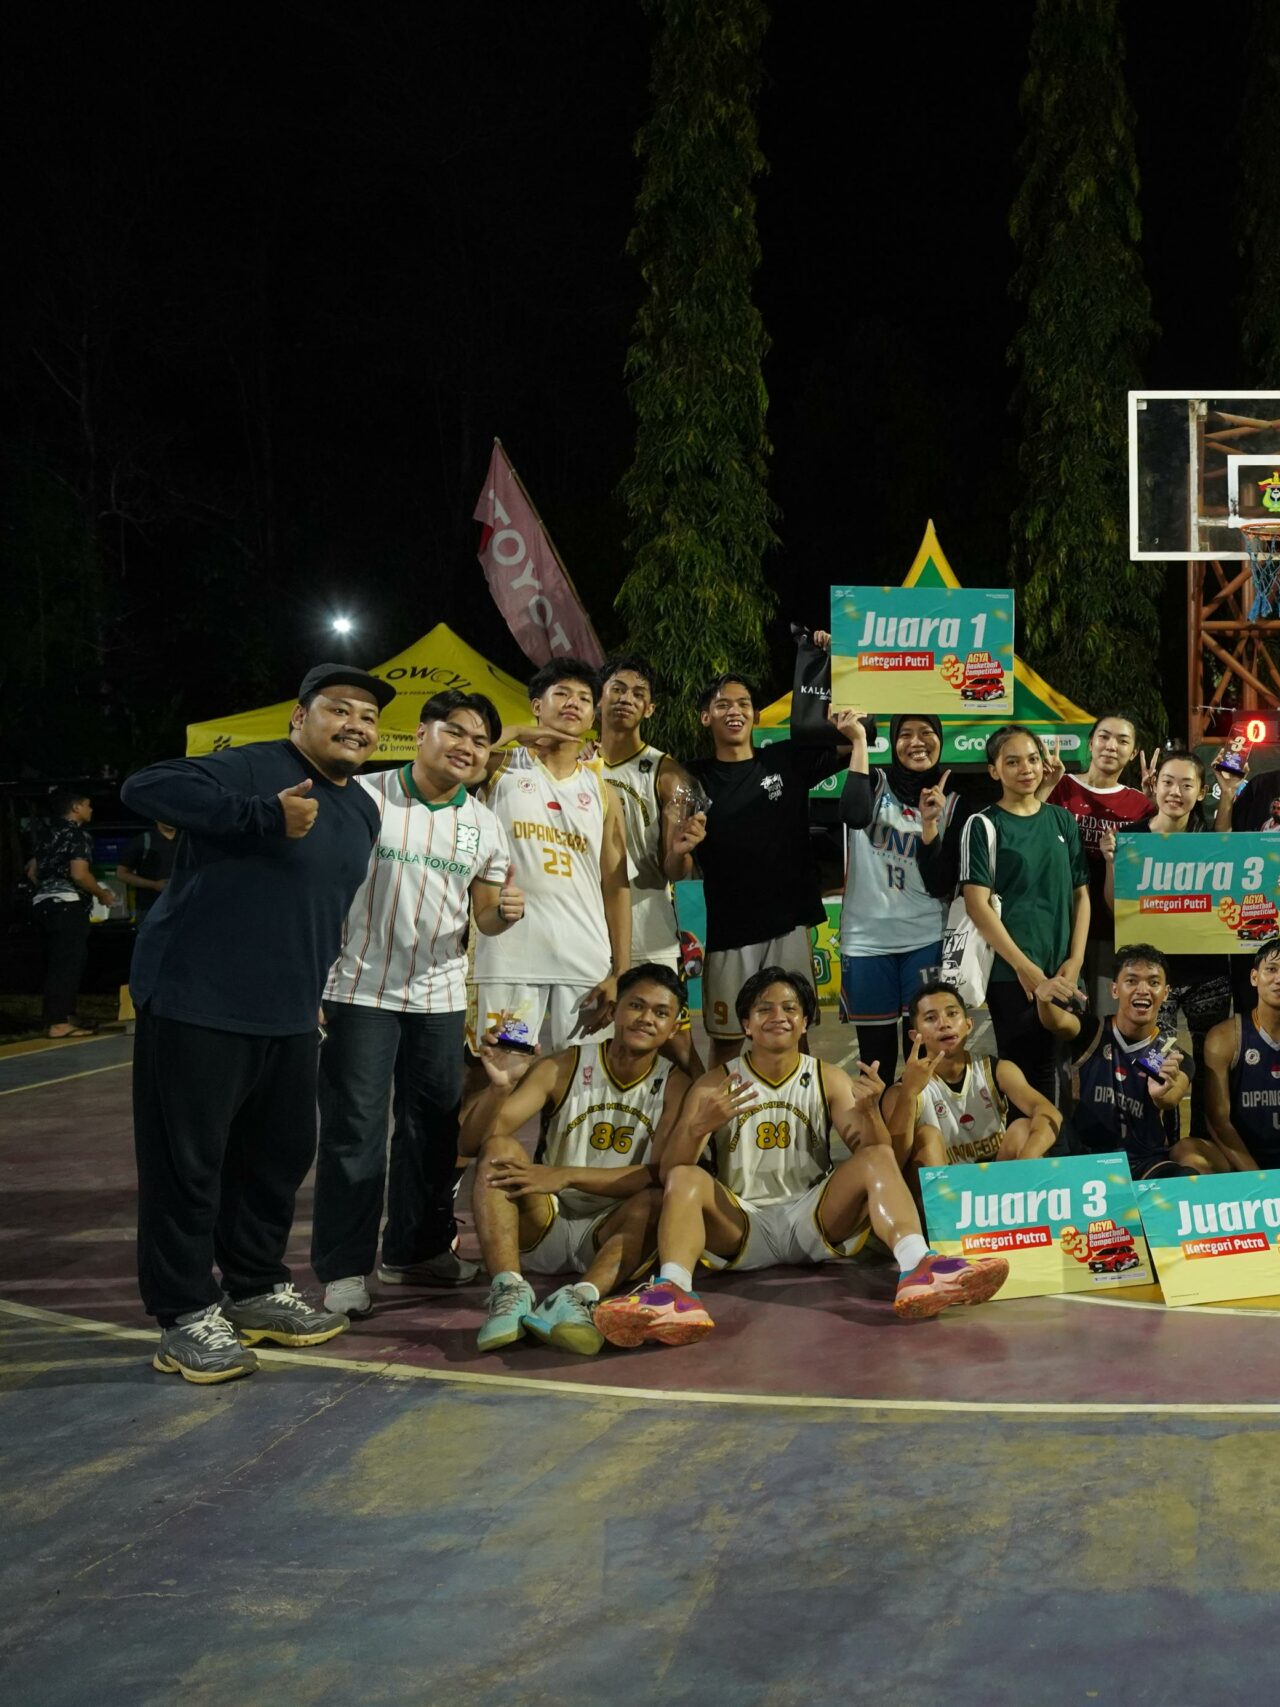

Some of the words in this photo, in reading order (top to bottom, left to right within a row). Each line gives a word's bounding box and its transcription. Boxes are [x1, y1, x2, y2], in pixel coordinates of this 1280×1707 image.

[488, 489, 572, 651] TOYOT
[858, 611, 961, 648] Juara
[971, 613, 987, 648] 1
[905, 655, 930, 667] Putri
[385, 664, 473, 690] OWCYL
[800, 685, 832, 695] KALLA
[954, 734, 990, 751] Gra
[1246, 720, 1266, 742] 0
[872, 828, 919, 858] UN
[376, 847, 420, 863] KALLA
[423, 856, 472, 876] TOYOTA
[542, 847, 573, 878] 23
[1136, 857, 1234, 891] Juara
[1241, 856, 1265, 891] 3
[886, 864, 906, 890] 13
[1184, 897, 1207, 909] Putri
[713, 1001, 728, 1025] 9
[590, 1122, 634, 1154] 86
[756, 1120, 791, 1150] 88
[956, 1188, 1071, 1229] Juara
[1082, 1180, 1107, 1217] 3
[1016, 1232, 1047, 1245] Putra
[1234, 1238, 1265, 1251] Putra
